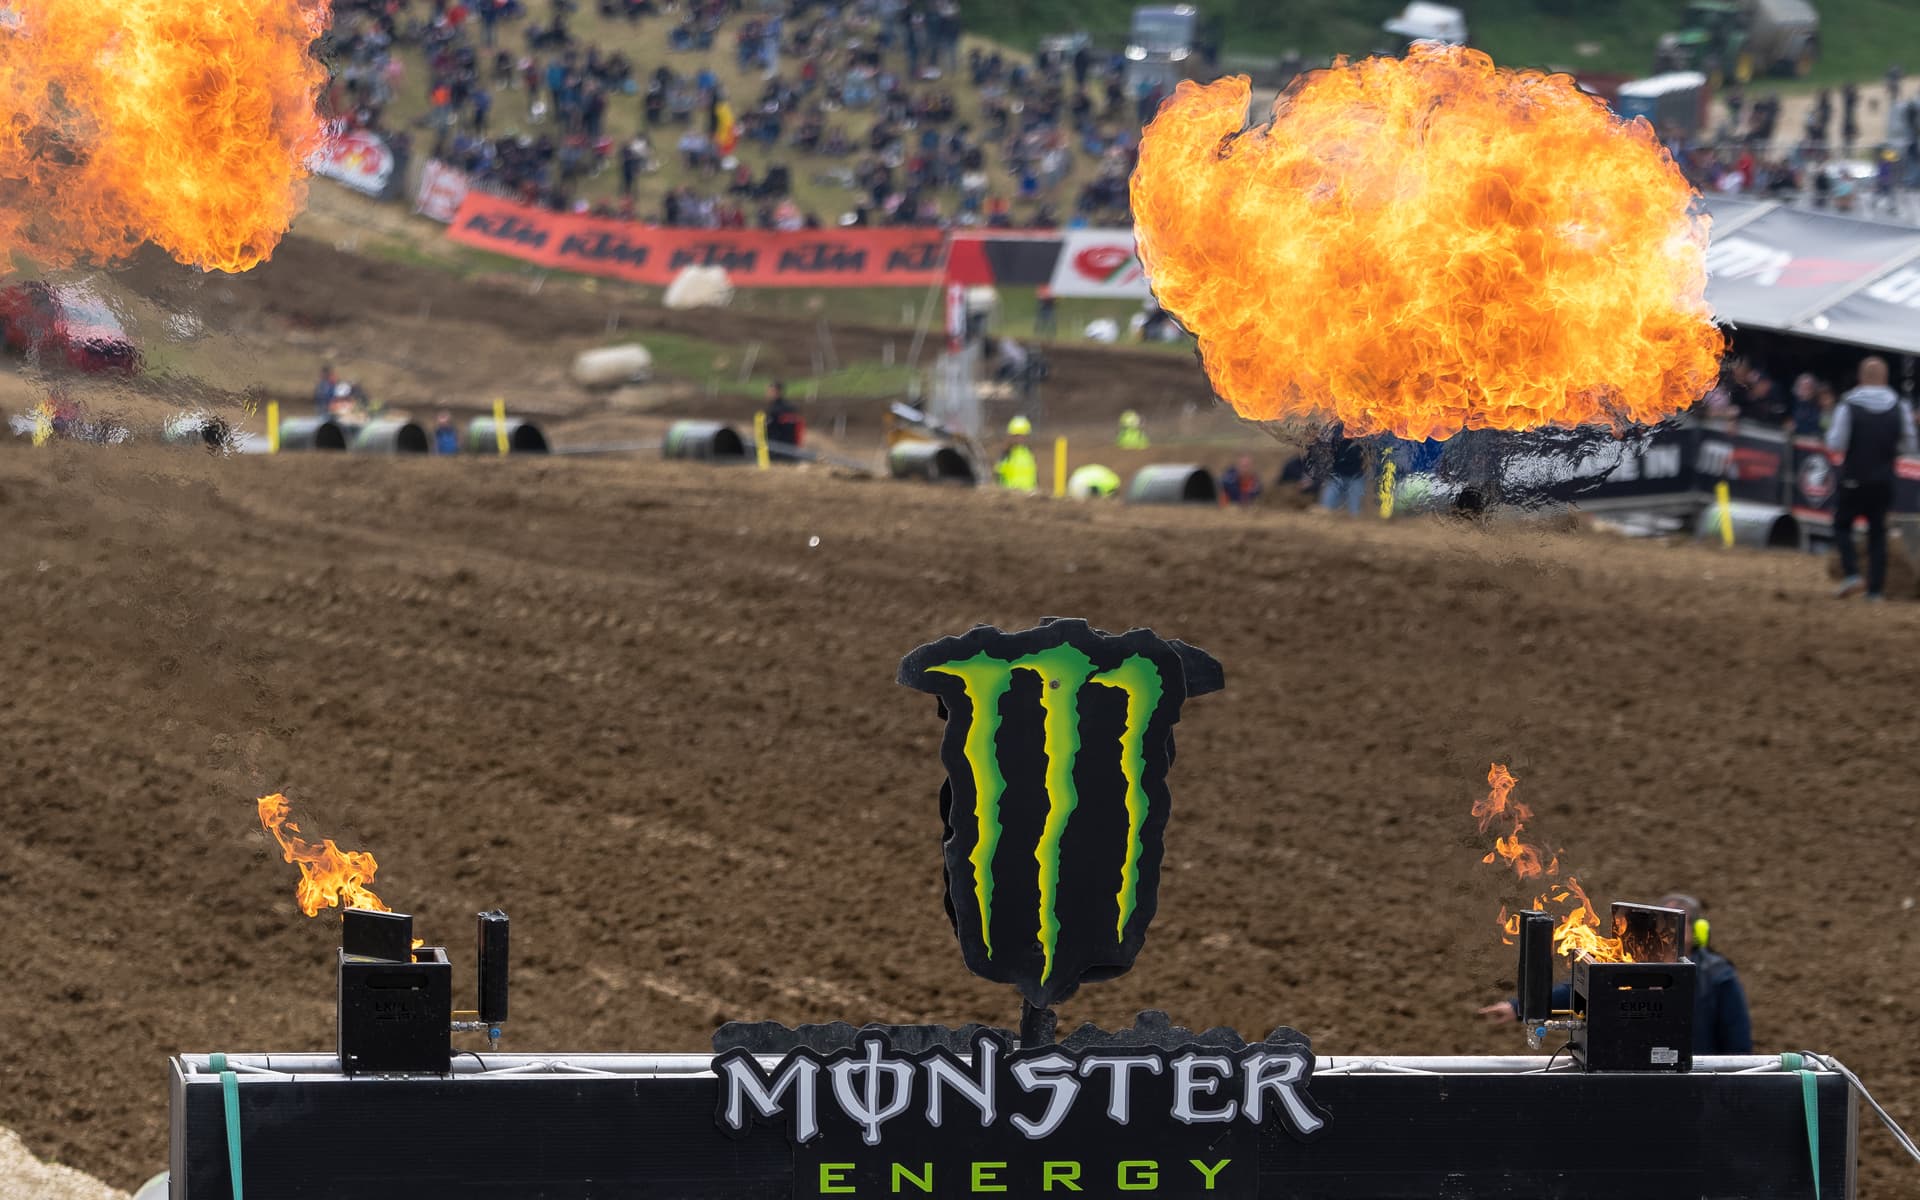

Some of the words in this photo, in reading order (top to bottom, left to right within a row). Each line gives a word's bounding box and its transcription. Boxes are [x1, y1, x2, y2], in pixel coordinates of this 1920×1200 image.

[464, 212, 548, 249] KTM
[559, 231, 648, 267] KTM
[776, 243, 867, 272] KTM
[721, 1038, 1325, 1146] MONSTER
[818, 1158, 1232, 1194] ENERGY
